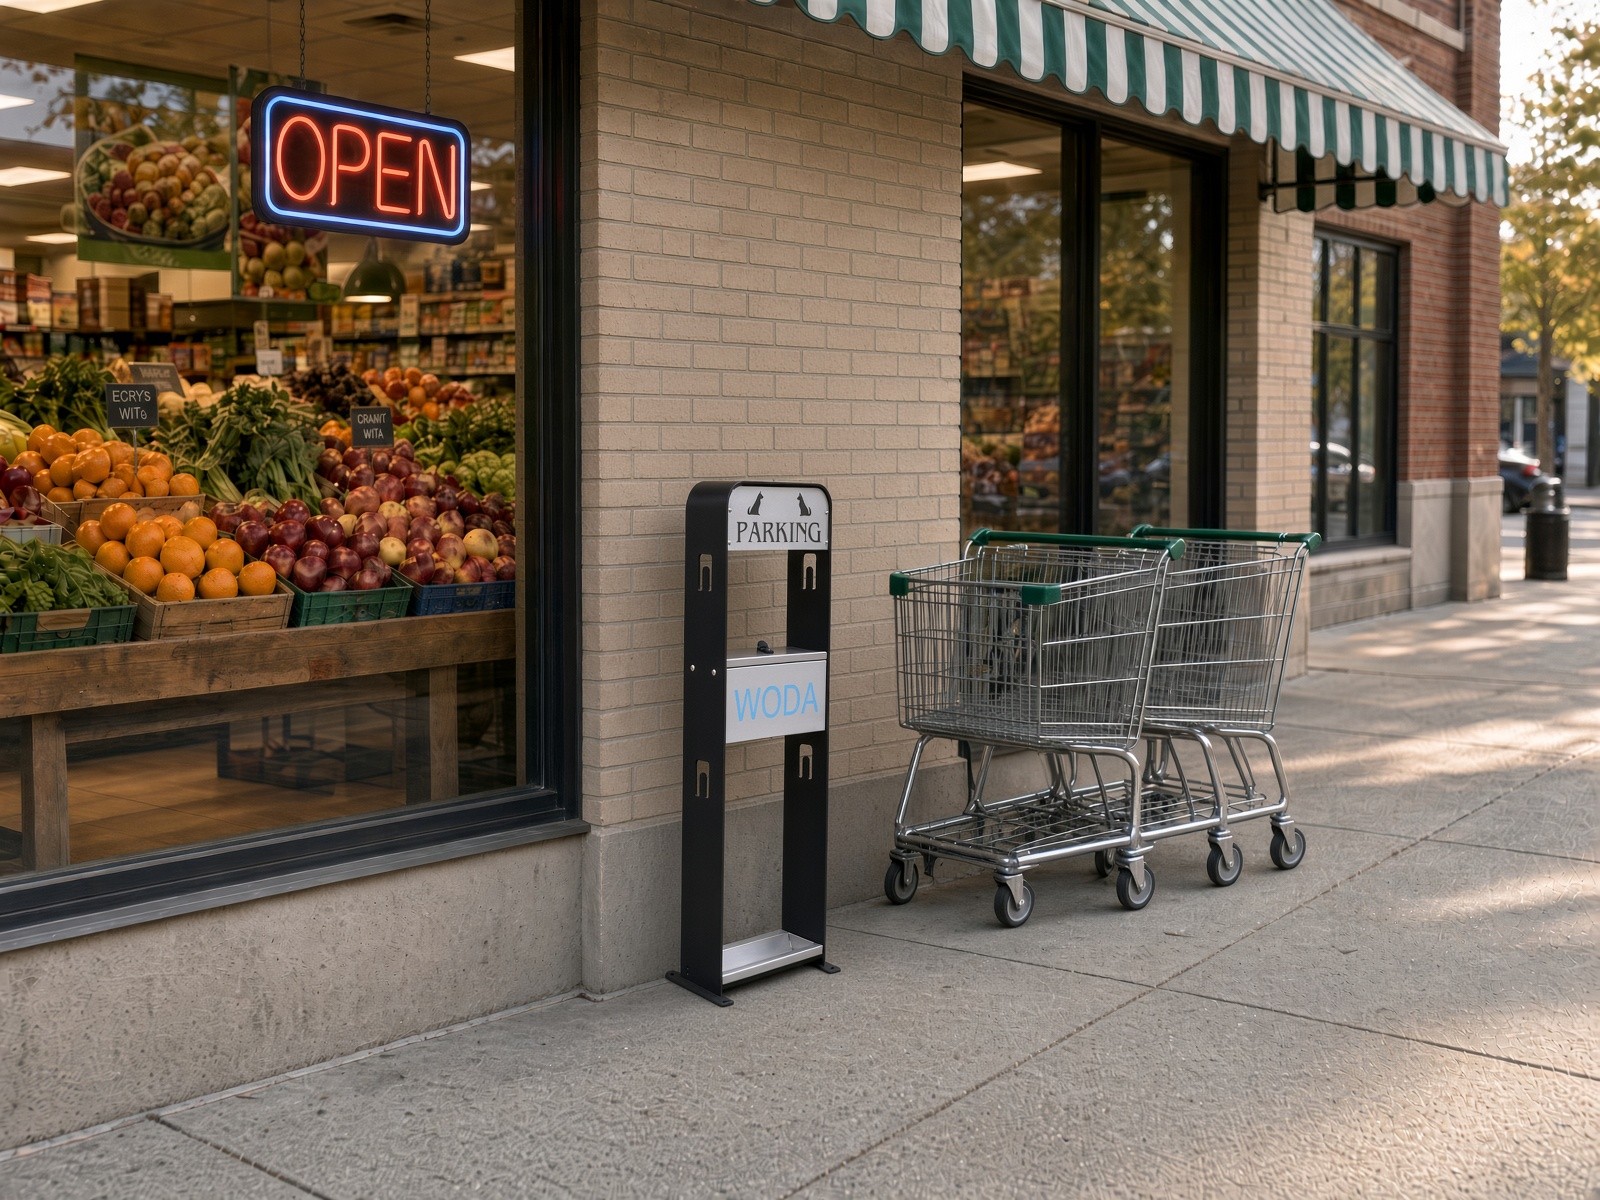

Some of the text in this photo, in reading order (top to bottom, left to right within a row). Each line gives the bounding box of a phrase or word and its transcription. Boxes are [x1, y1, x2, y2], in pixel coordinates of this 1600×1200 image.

[276, 116, 456, 220] OPEN
[112, 389, 151, 402] ECRYS
[736, 521, 821, 543] PARKING
[734, 681, 819, 722] WODA
